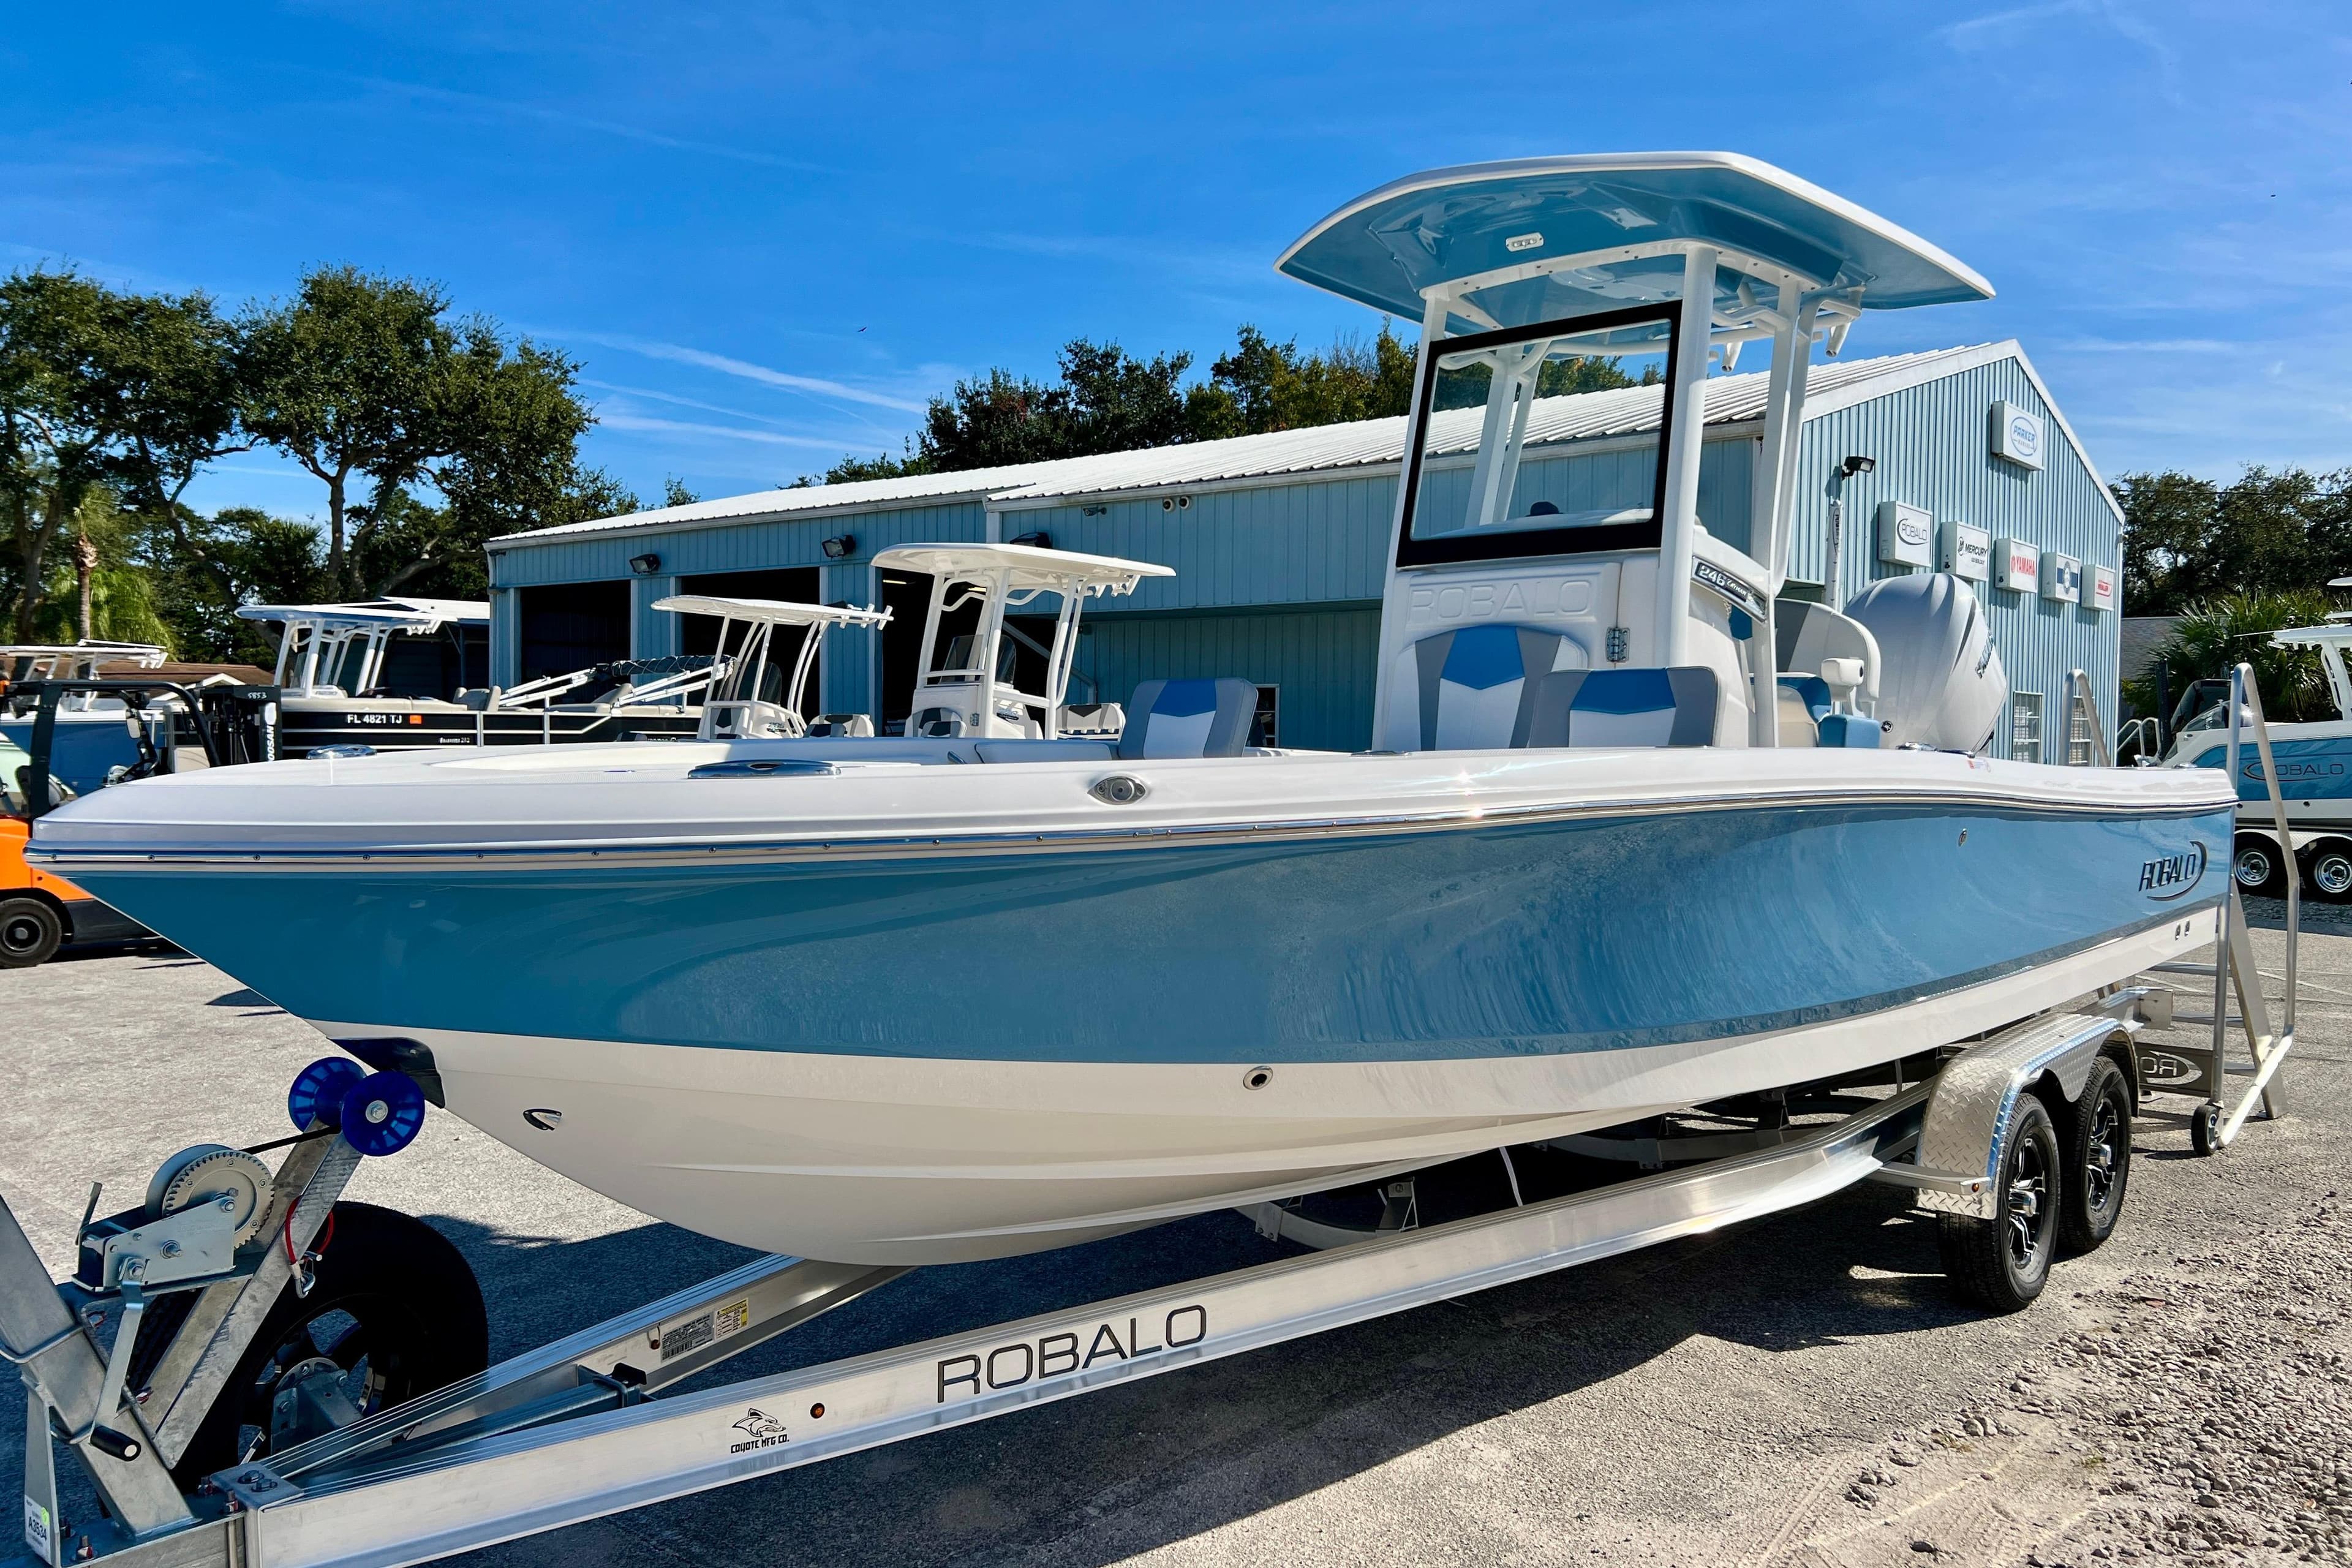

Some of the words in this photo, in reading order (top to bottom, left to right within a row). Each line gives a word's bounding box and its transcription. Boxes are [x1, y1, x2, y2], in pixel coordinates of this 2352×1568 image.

[2013, 425, 2035, 442] PARKER
[1901, 522, 1928, 541] ROBALO
[1964, 543, 1988, 557] MERCURY
[1698, 565, 1725, 586] 246
[2016, 556, 2035, 577] YAMAHA
[1409, 580, 1591, 620] ROBALO
[347, 714, 361, 724] FL
[363, 714, 386, 724] 4821
[390, 714, 402, 724] TJ
[266, 725, 275, 761] OOSAN
[2263, 764, 2344, 775] OBALO
[2138, 853, 2196, 892] ROBALO
[937, 1304, 1207, 1403] ROBALO
[731, 1439, 760, 1453] COYOTE
[761, 1436, 776, 1448] MFG
[778, 1434, 790, 1444] CO.
